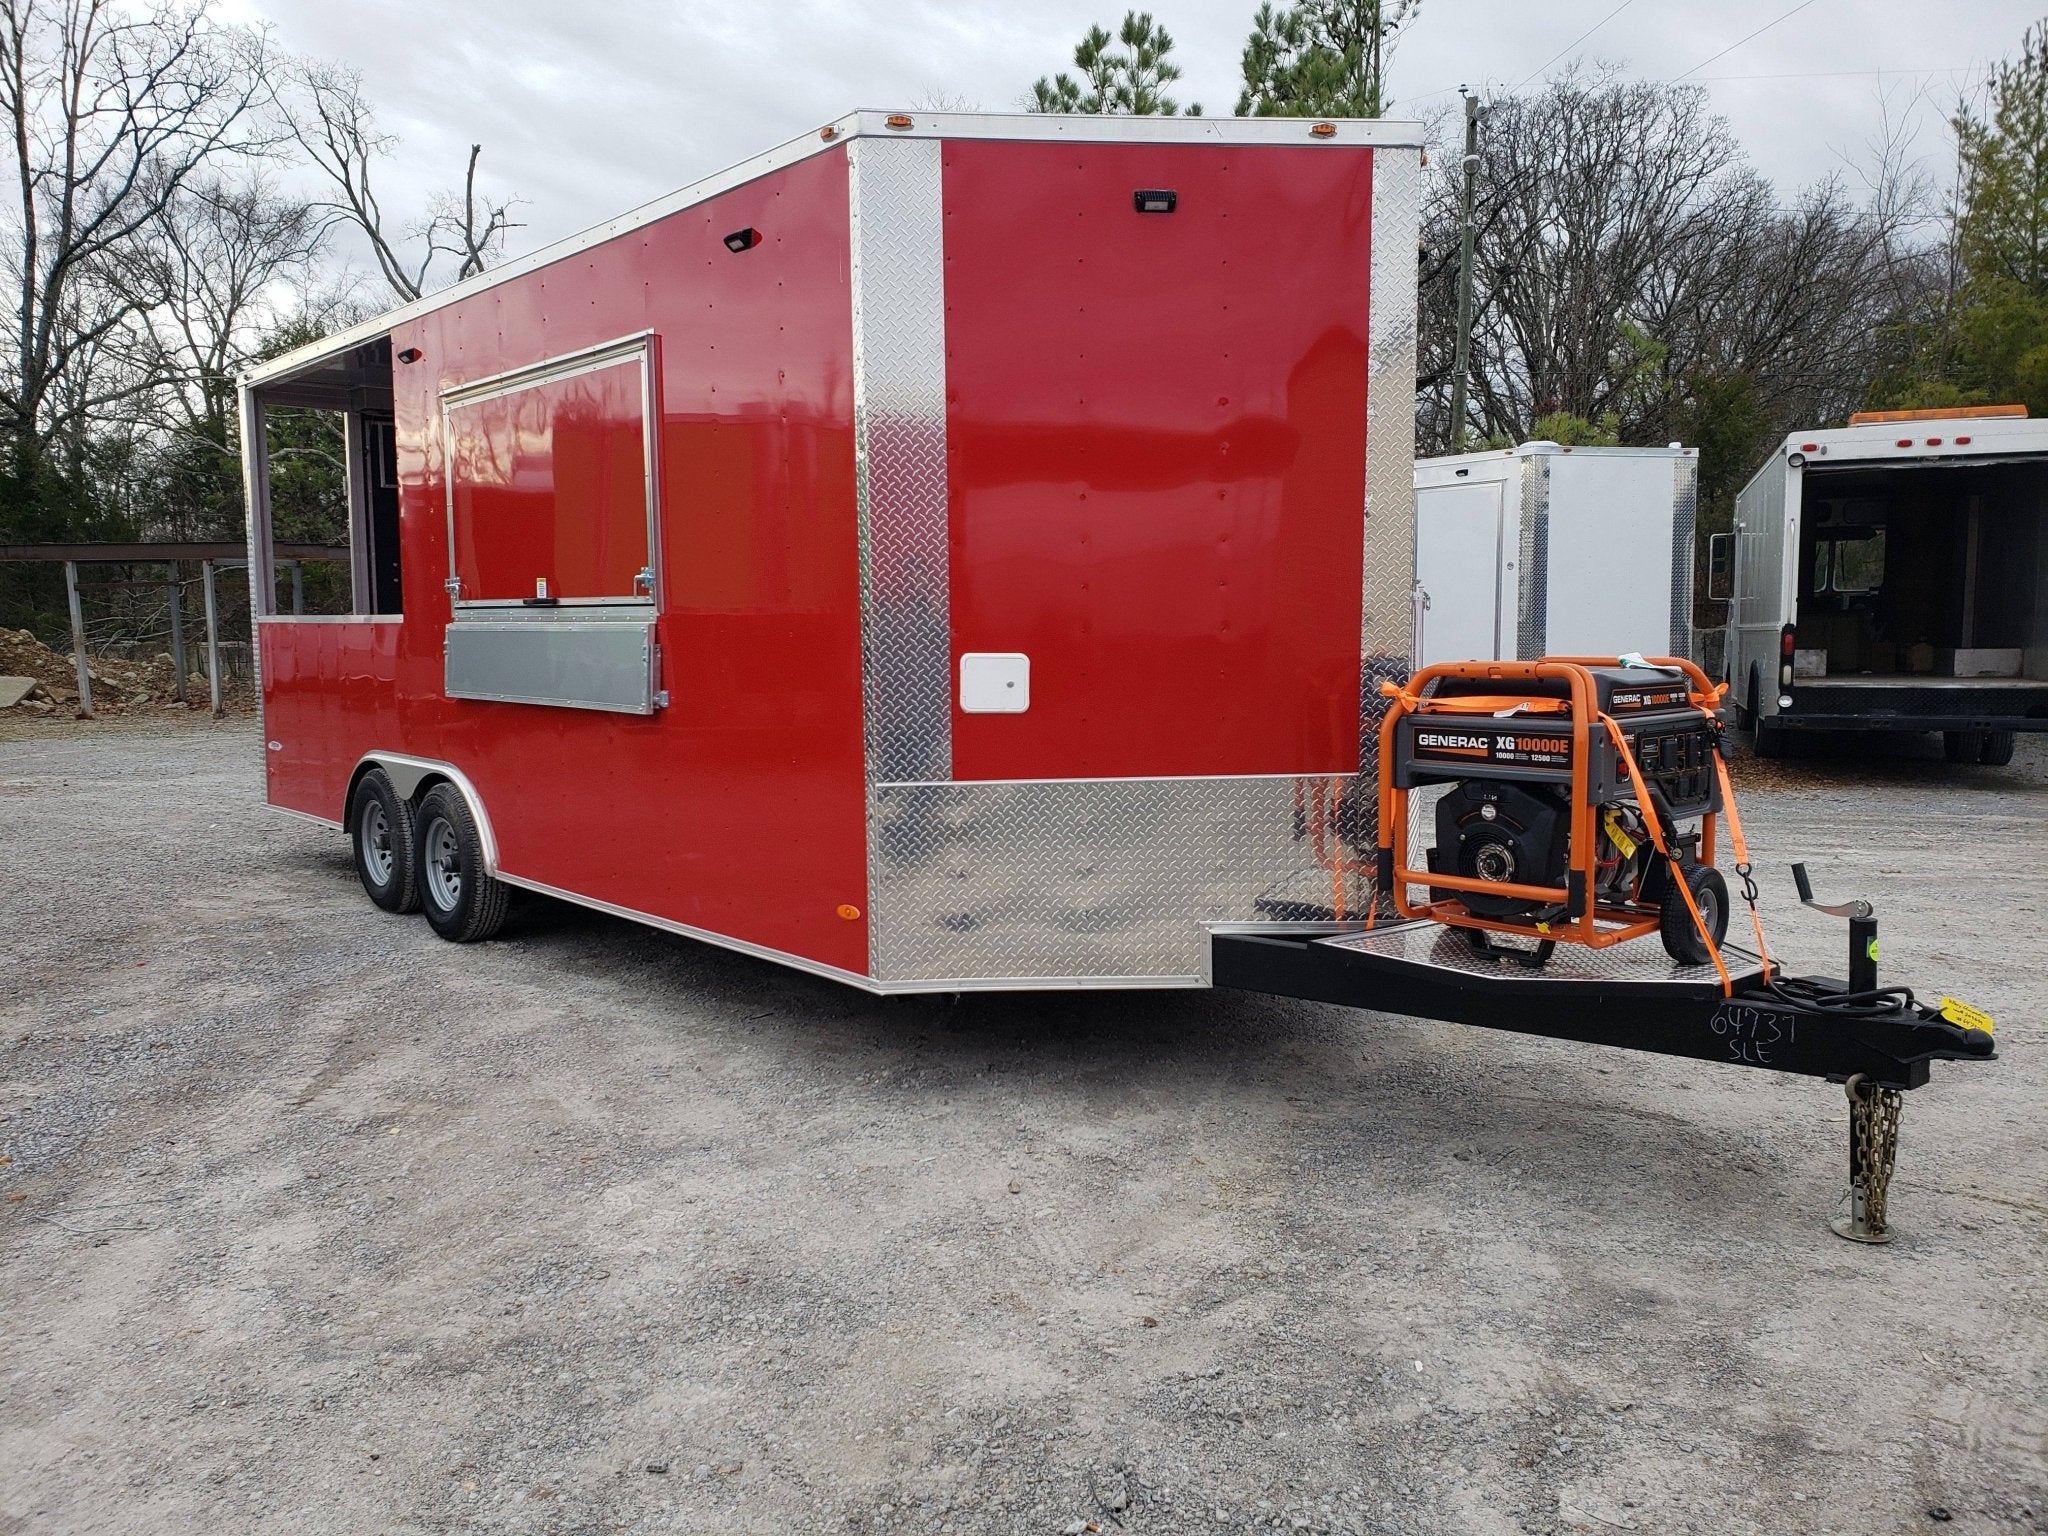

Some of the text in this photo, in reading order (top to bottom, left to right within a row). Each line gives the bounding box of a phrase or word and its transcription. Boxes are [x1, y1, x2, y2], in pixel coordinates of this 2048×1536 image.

[1612, 694, 1641, 704] GENERAC
[1418, 734, 1488, 749] GENERAC
[1495, 752, 1515, 760] 10000
[1531, 754, 1551, 762] 12500
[1729, 1039, 1773, 1063] SLE
